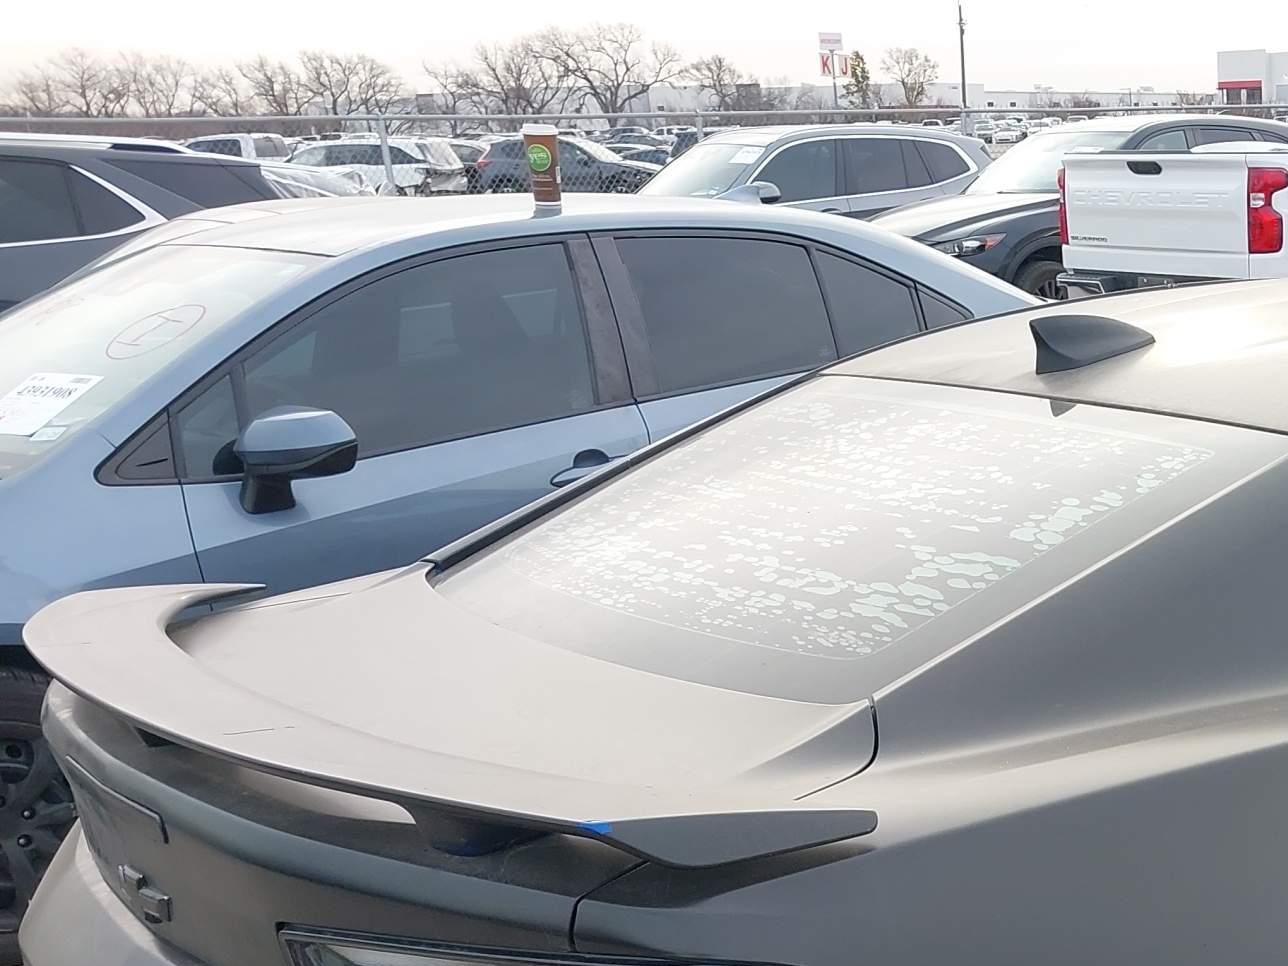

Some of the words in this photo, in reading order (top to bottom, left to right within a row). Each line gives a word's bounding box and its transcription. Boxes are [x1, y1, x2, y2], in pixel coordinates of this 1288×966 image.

[821, 55, 832, 74] K
[841, 57, 848, 75] J
[1072, 189, 1230, 208] CHEVROLET
